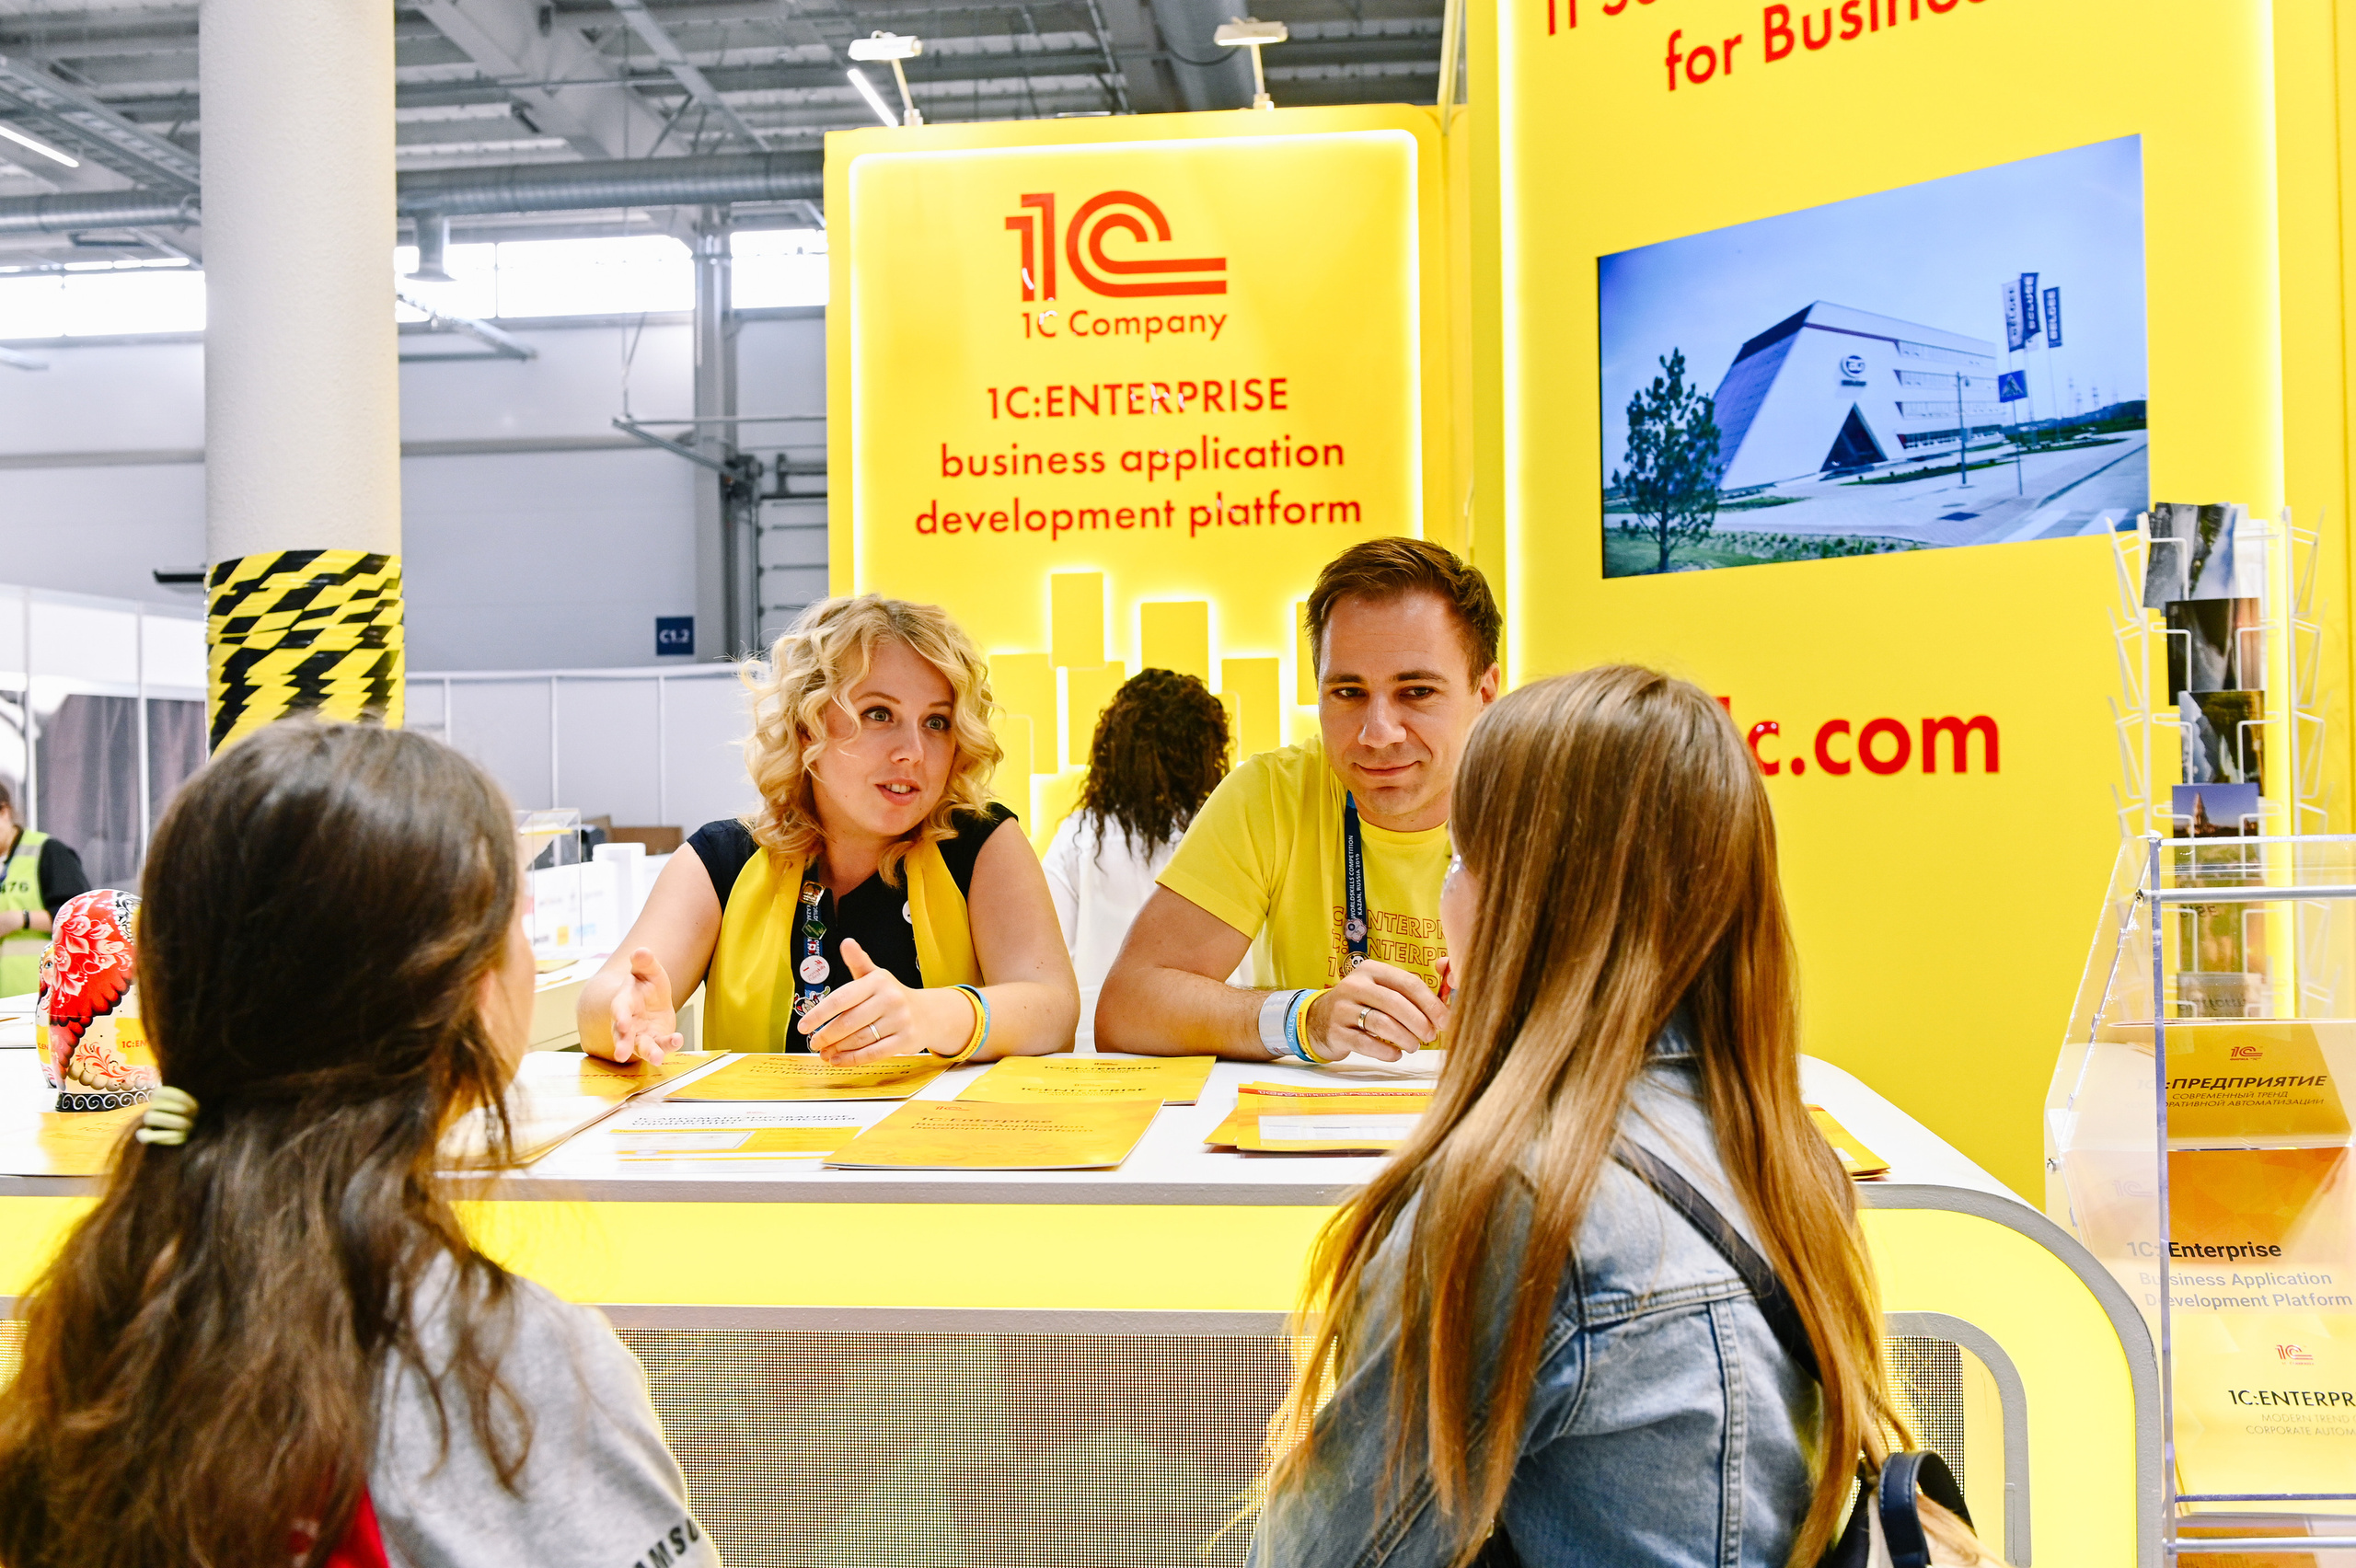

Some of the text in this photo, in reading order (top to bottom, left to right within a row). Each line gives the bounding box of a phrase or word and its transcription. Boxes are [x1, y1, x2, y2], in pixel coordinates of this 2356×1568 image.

[1665, 0, 1986, 92] for Busin
[1022, 308, 1228, 342] 1C Company
[987, 377, 1288, 420] 1C:ENTERPRISE
[941, 434, 1344, 482] business application
[915, 489, 1362, 541] development platform
[1717, 696, 2000, 777] c.com
[1348, 877, 1357, 918] WORLDSKILLS
[121, 1040, 148, 1049] 1C:EN
[2172, 1090, 2289, 1100] СОВРЕМЕННЫЙ ТРЕНД
[2226, 1099, 2325, 1107] АВТОМАТИЗАЦИИ
[2231, 1272, 2333, 1290] Application
[2272, 1292, 2354, 1308] Platform
[2228, 1389, 2356, 1407] 1C:ENTERPR
[2261, 1412, 2312, 1424] MODERN
[2315, 1413, 2350, 1424] TREND
[2246, 1424, 2356, 1436] CORPORATE AUTOM
